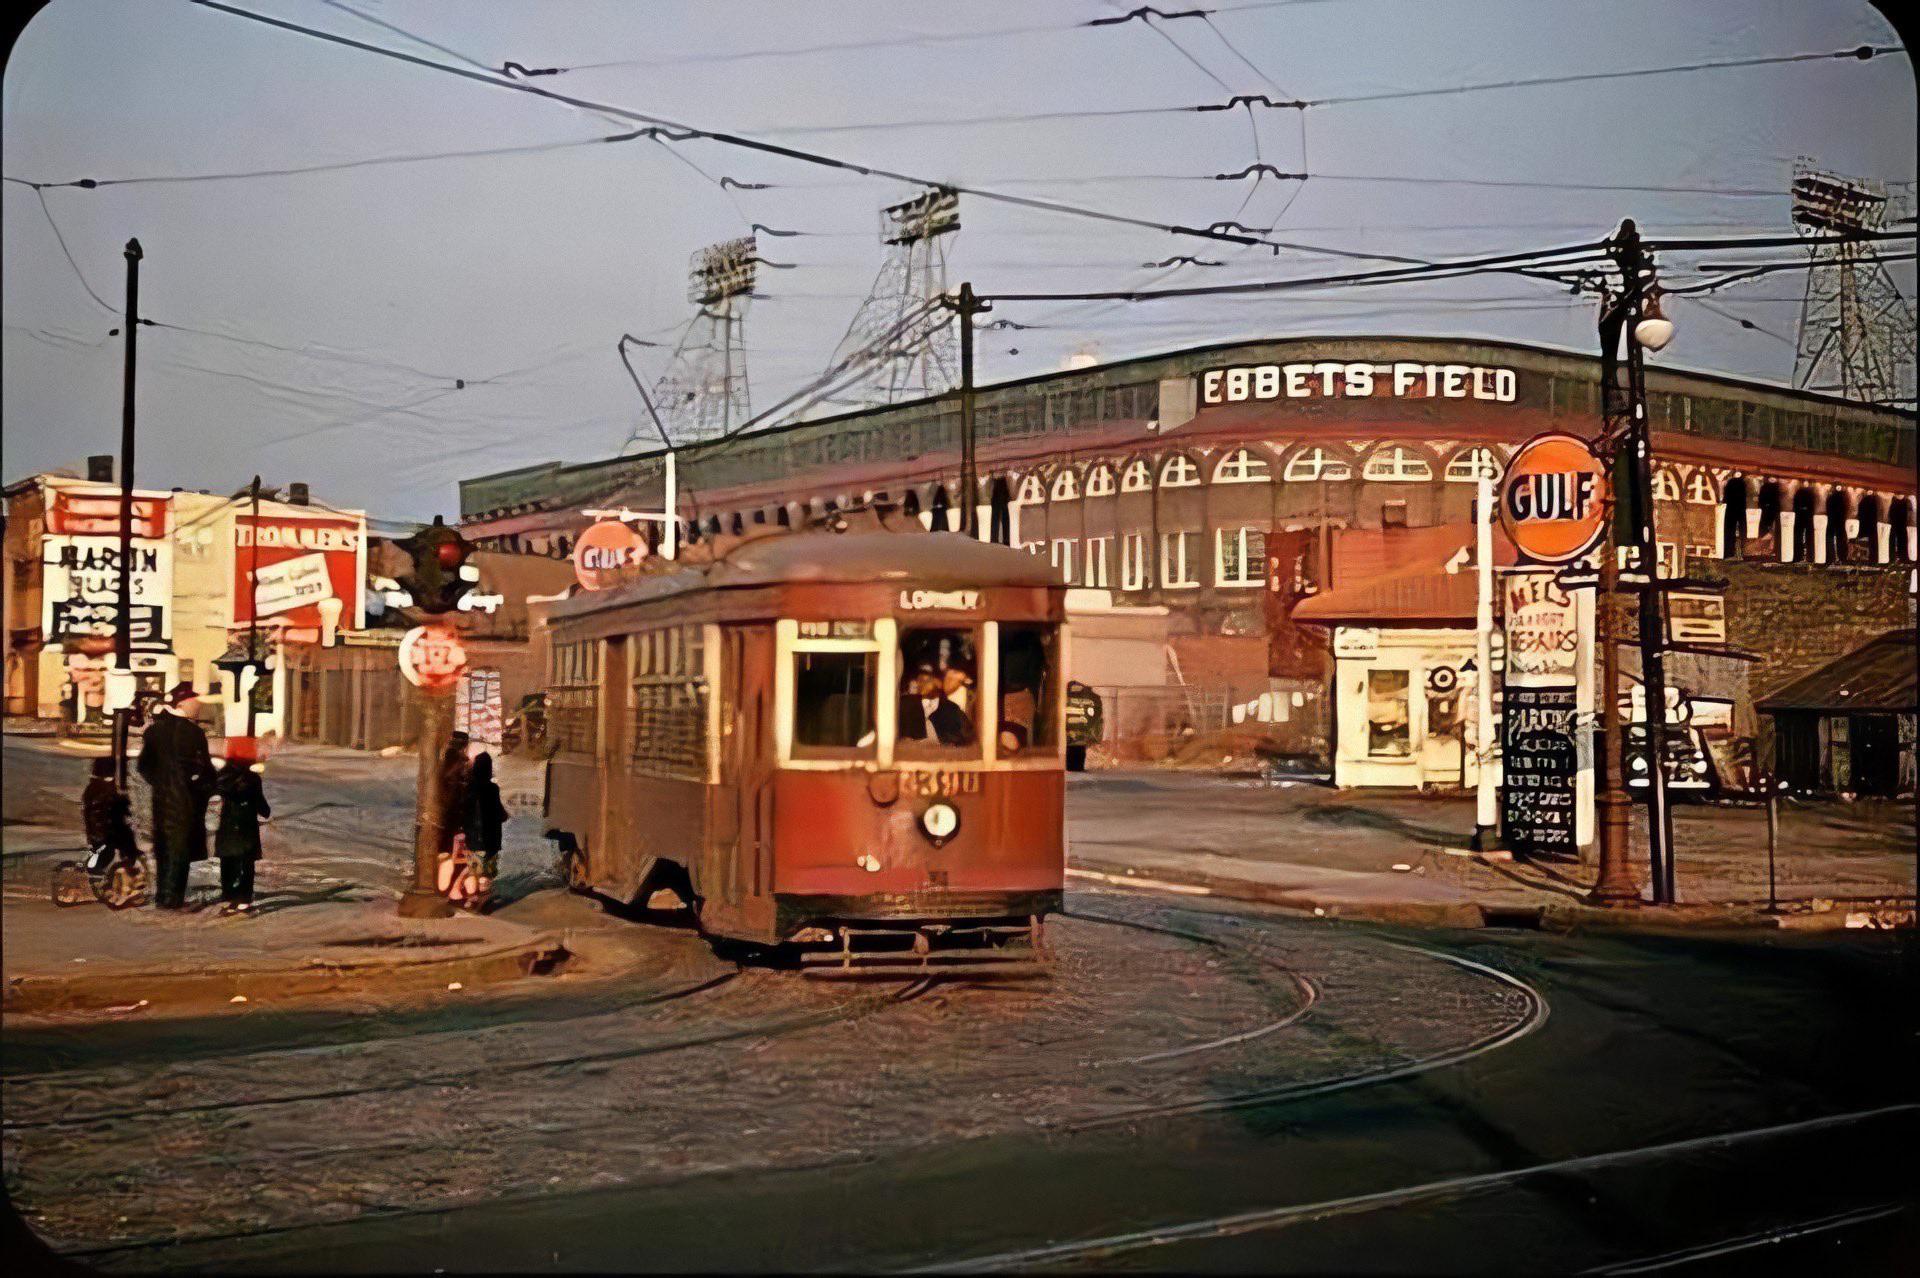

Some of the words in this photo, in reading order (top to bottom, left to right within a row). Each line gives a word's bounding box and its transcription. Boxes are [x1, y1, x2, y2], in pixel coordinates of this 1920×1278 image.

[1204, 362, 1374, 403] EBBETS
[1394, 363, 1516, 402] FIELD
[1507, 471, 1594, 521] GULF
[61, 545, 157, 573] MARIN
